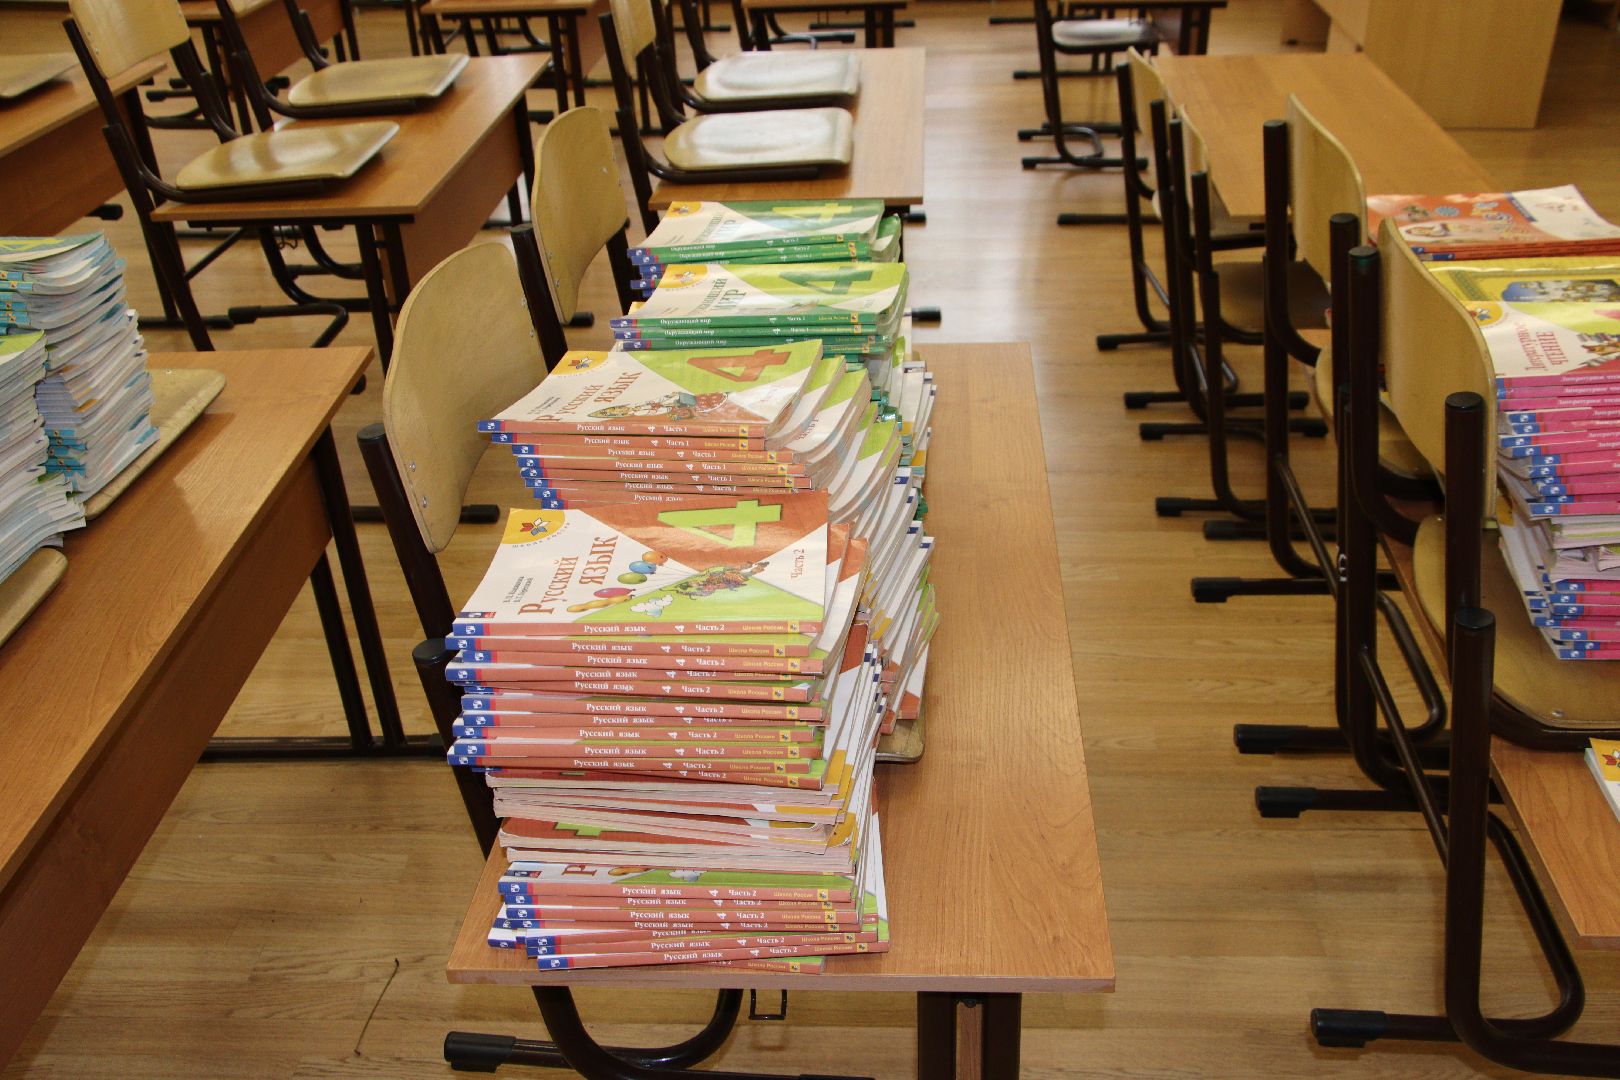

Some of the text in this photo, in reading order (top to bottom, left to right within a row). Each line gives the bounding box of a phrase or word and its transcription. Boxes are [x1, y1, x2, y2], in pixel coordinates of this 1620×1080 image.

[779, 265, 874, 295] 4
[686, 349, 792, 383] 4
[658, 499, 782, 548] 4
[579, 535, 619, 585] язык
[517, 555, 579, 615] Русский
[584, 625, 619, 634] Русский
[572, 642, 607, 652] Русский
[587, 656, 622, 665] Русский
[696, 658, 719, 666] Часть
[575, 670, 611, 679] Русский
[575, 681, 609, 690] Русский
[586, 703, 621, 712] Русский
[593, 716, 628, 724] Русский
[579, 730, 614, 738] Русский
[585, 747, 620, 755] Русский
[695, 747, 719, 755] Часть
[574, 760, 609, 768] Русский
[623, 887, 656, 896] Русский
[728, 889, 751, 897] Часть
[627, 897, 661, 906] Русский
[630, 911, 664, 920] Русский
[634, 921, 668, 929] Русский
[652, 929, 687, 938] Русский
[651, 942, 685, 950] Русский
[664, 952, 698, 961] Русский
